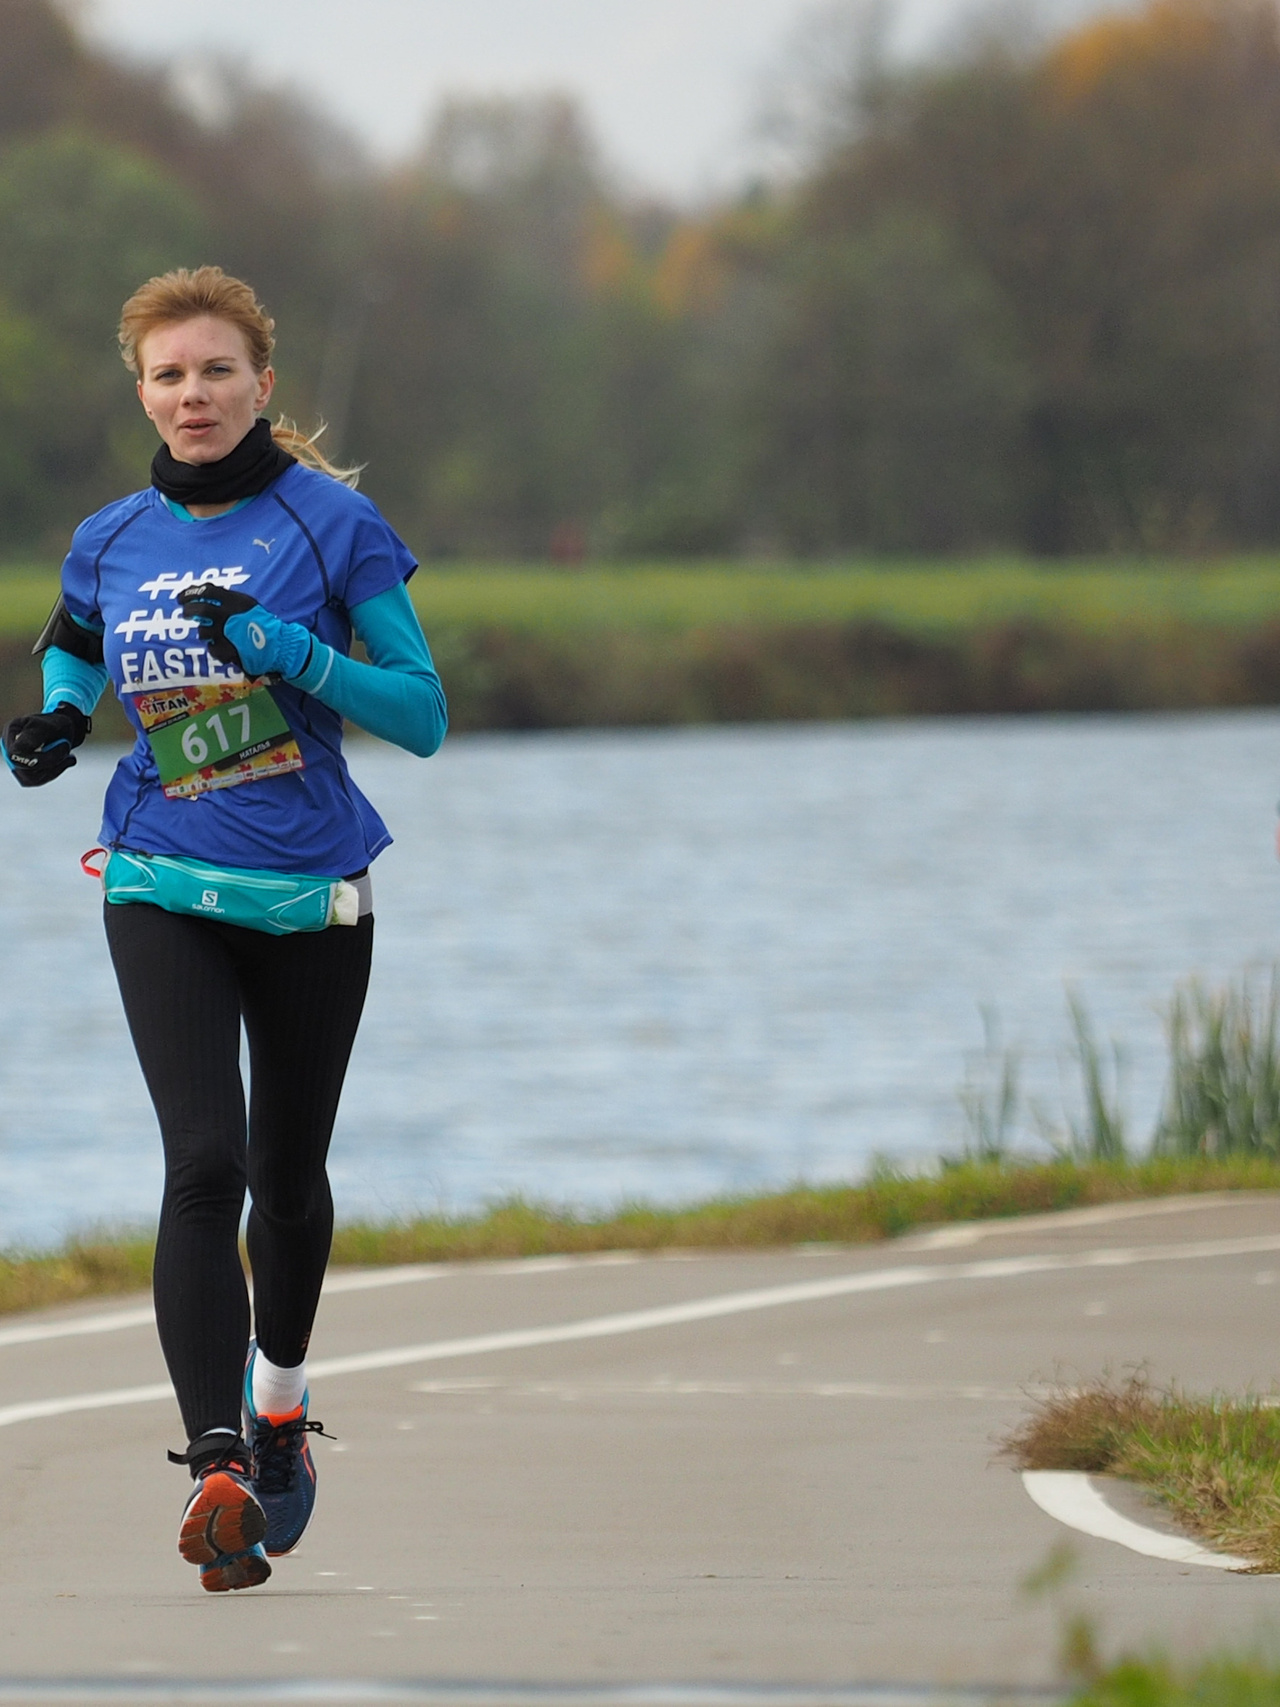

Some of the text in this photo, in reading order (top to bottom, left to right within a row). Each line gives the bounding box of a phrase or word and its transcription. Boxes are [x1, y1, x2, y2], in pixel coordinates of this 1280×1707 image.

[148, 565, 243, 600] FAST
[124, 607, 200, 643] FAS
[141, 697, 189, 715] TITAN
[181, 703, 250, 764] 617
